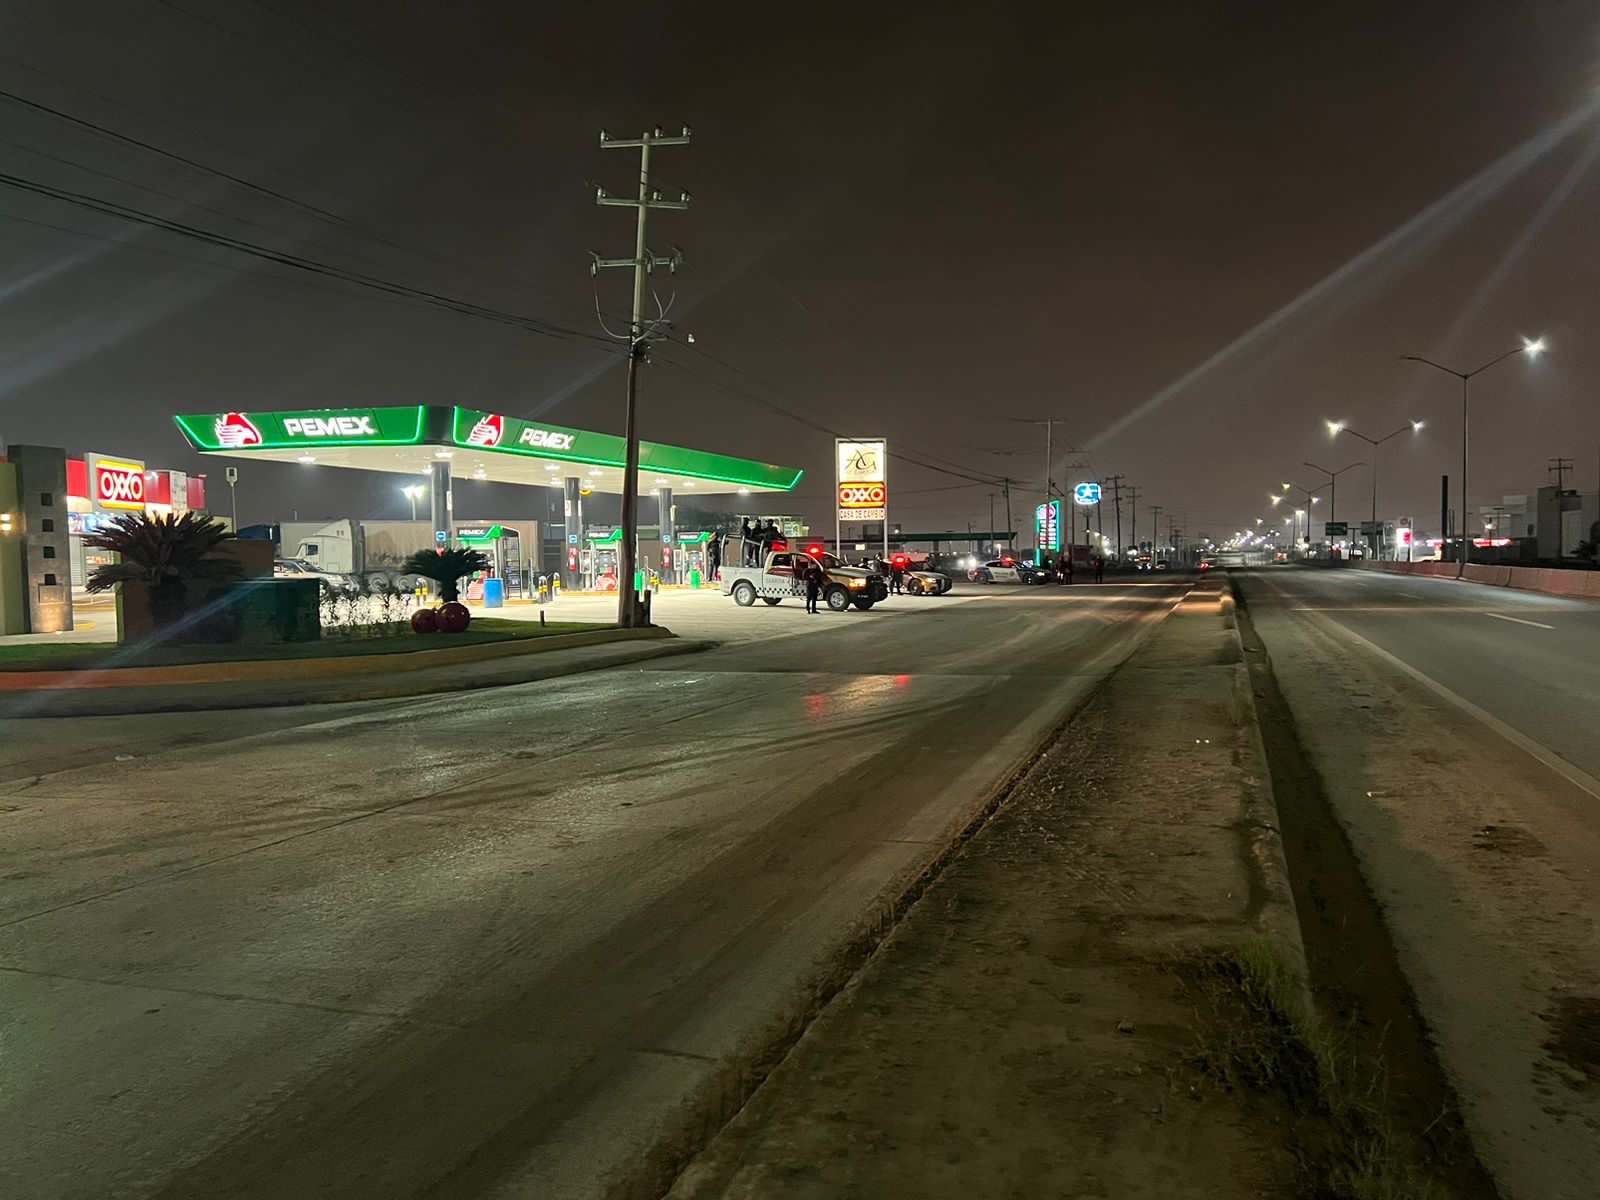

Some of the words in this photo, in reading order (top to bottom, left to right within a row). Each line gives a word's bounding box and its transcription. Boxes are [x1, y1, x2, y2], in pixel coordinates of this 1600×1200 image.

[283, 416, 378, 437] PEMEX
[519, 427, 575, 450] PEMEX
[100, 471, 143, 501] OXXO
[840, 487, 884, 503] OXXO
[840, 509, 854, 519] CASA
[855, 509, 862, 519] DE
[863, 509, 884, 519] CAMBIO
